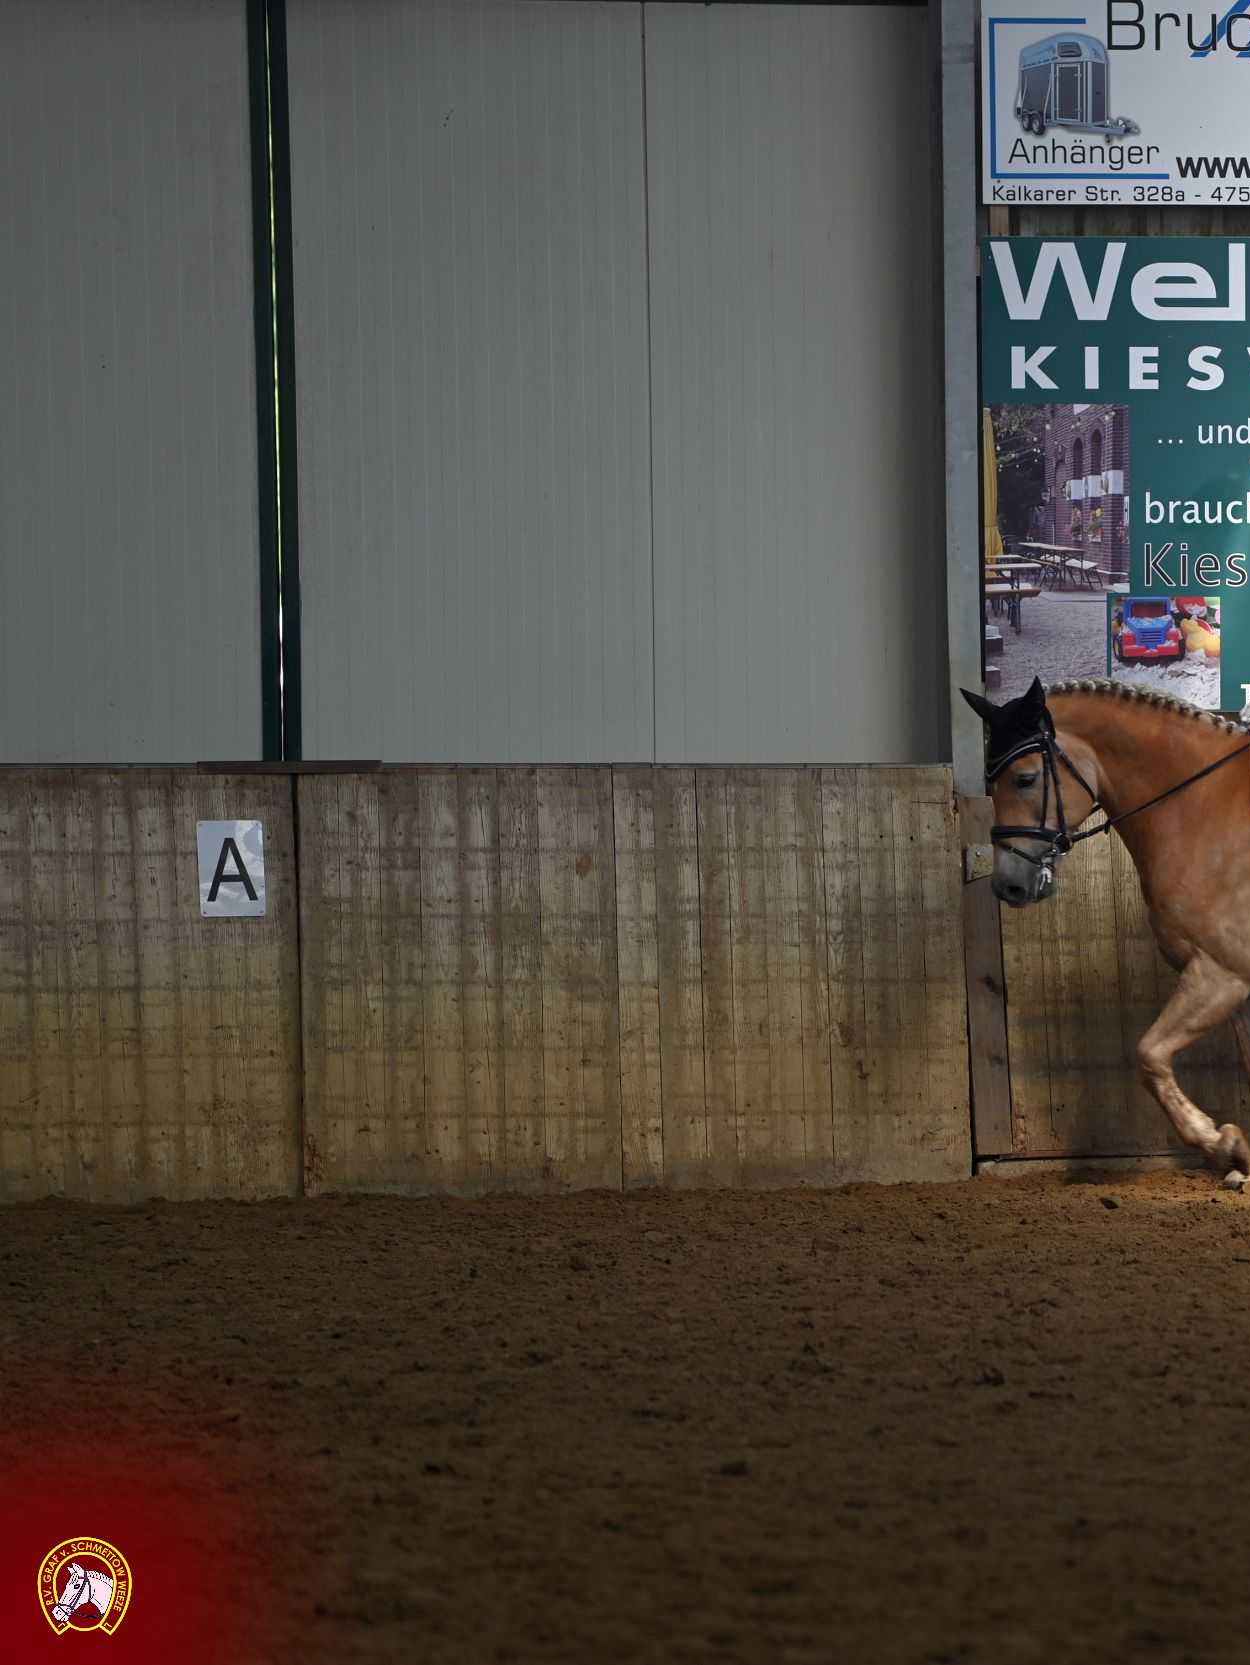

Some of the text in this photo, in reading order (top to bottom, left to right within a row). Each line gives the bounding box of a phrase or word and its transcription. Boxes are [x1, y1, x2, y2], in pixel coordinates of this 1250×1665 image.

[1008, 138, 1160, 170] Anhänger
[992, 185, 1077, 202] Kalkarer
[1085, 186, 1121, 202] Str.
[1132, 185, 1185, 202] 328a
[1144, 543, 1249, 587] Kies
[207, 837, 259, 902] A
